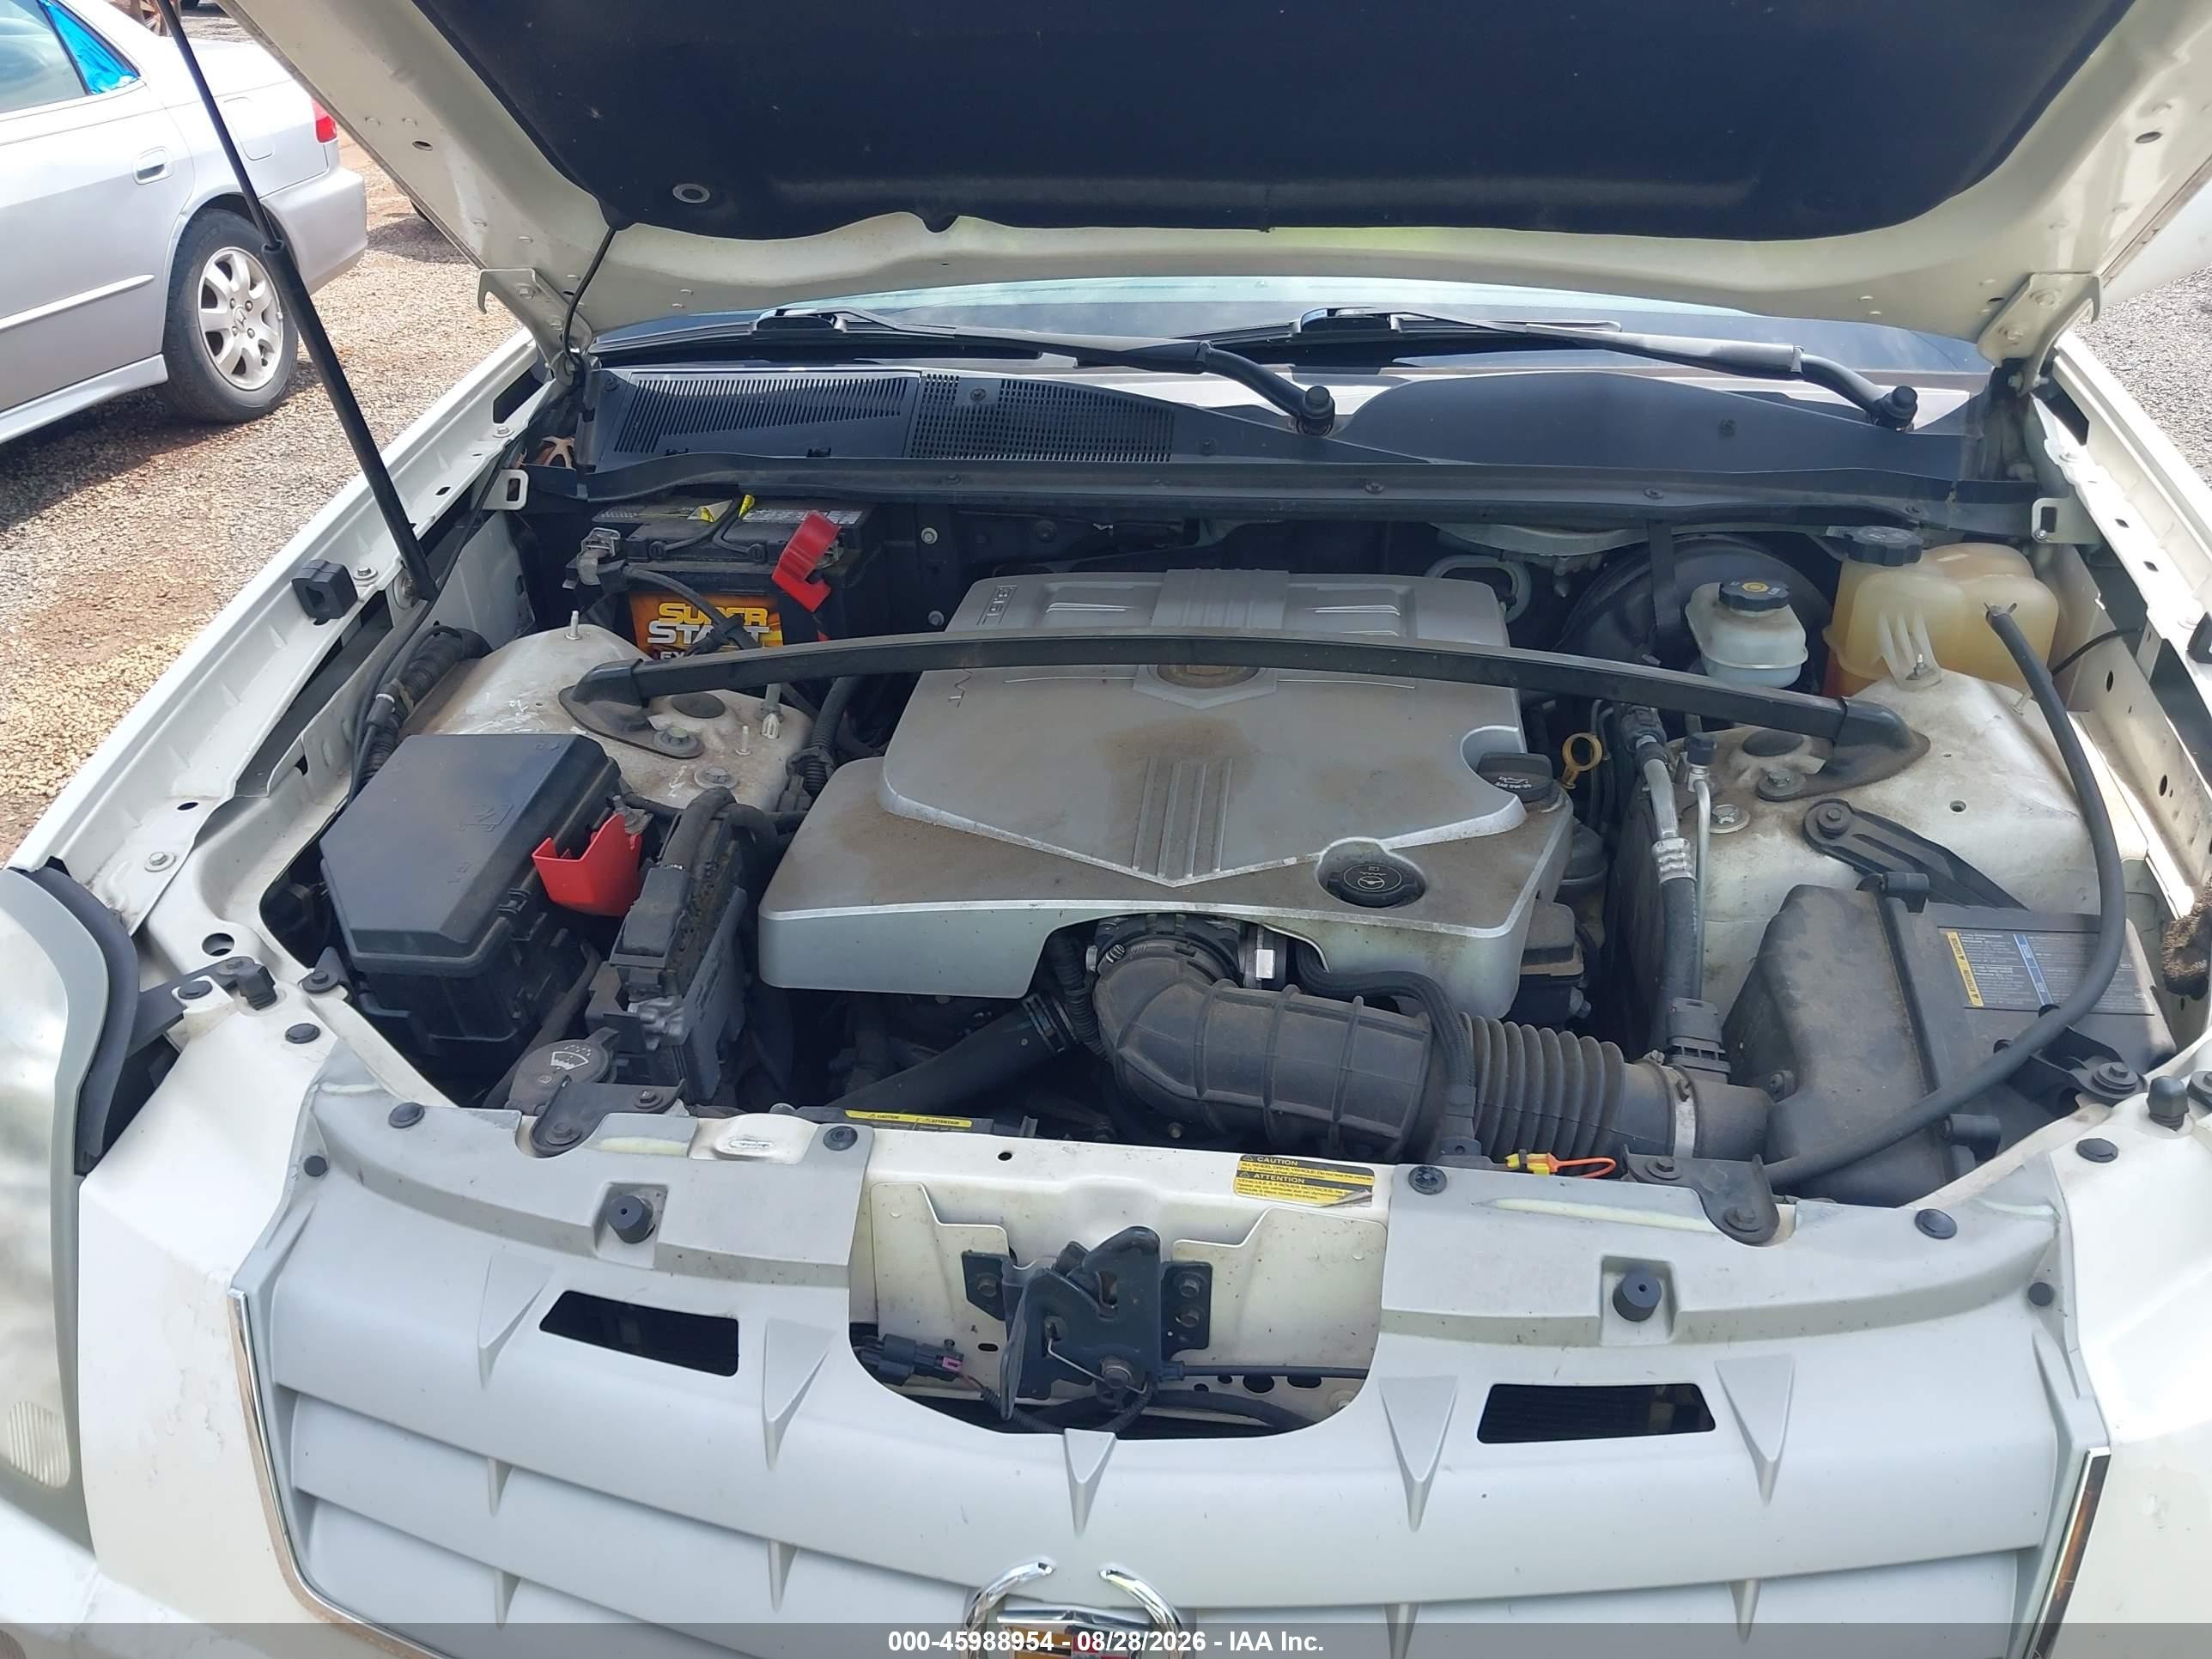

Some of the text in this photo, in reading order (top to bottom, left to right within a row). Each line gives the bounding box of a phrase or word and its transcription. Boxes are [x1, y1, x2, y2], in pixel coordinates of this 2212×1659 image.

[647, 620, 769, 645] STAT
[1257, 1157, 1298, 1166] CAUTION
[1254, 1173, 1305, 1183] ATTENTION
